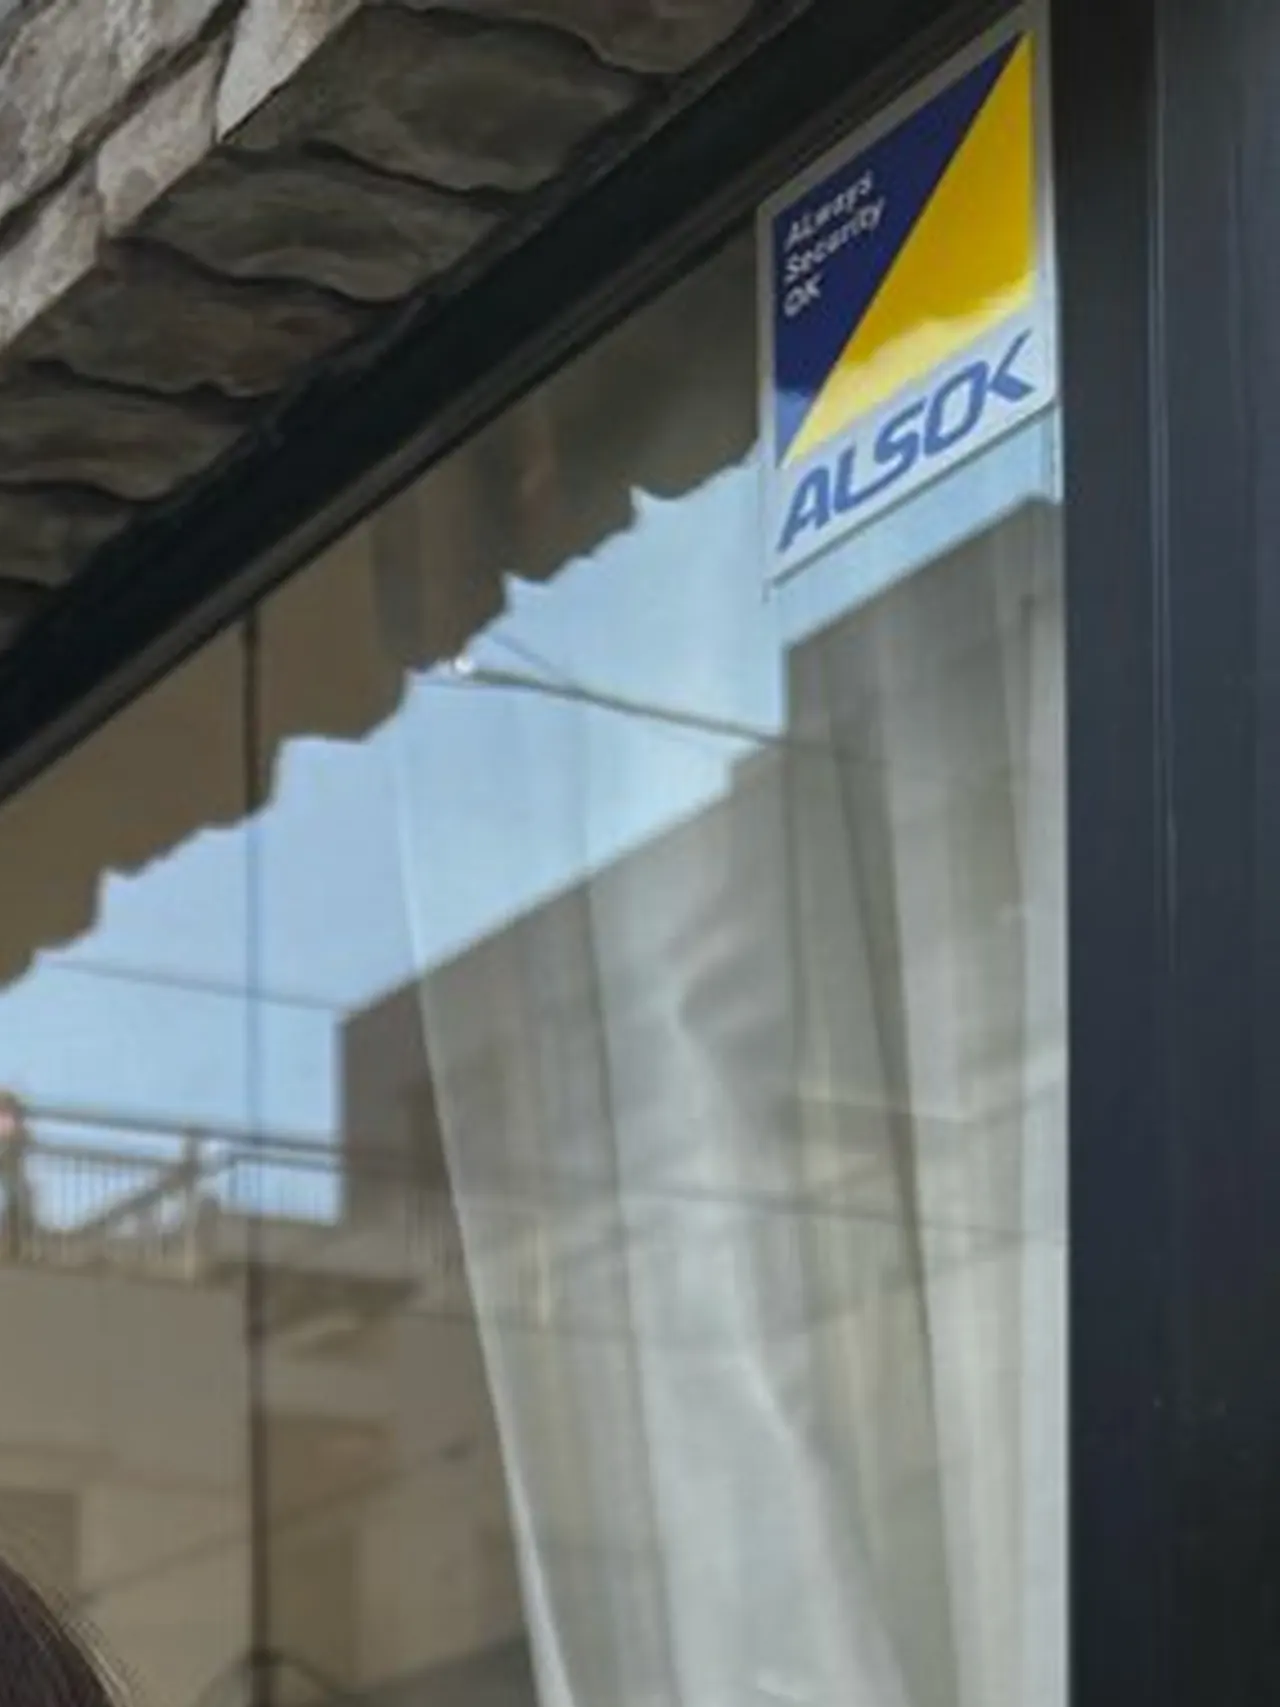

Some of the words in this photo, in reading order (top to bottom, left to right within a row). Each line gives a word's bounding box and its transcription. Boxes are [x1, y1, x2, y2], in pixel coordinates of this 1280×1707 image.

[784, 197, 886, 285] Security
[784, 272, 822, 317] OK
[777, 328, 1036, 553] ALSOK
